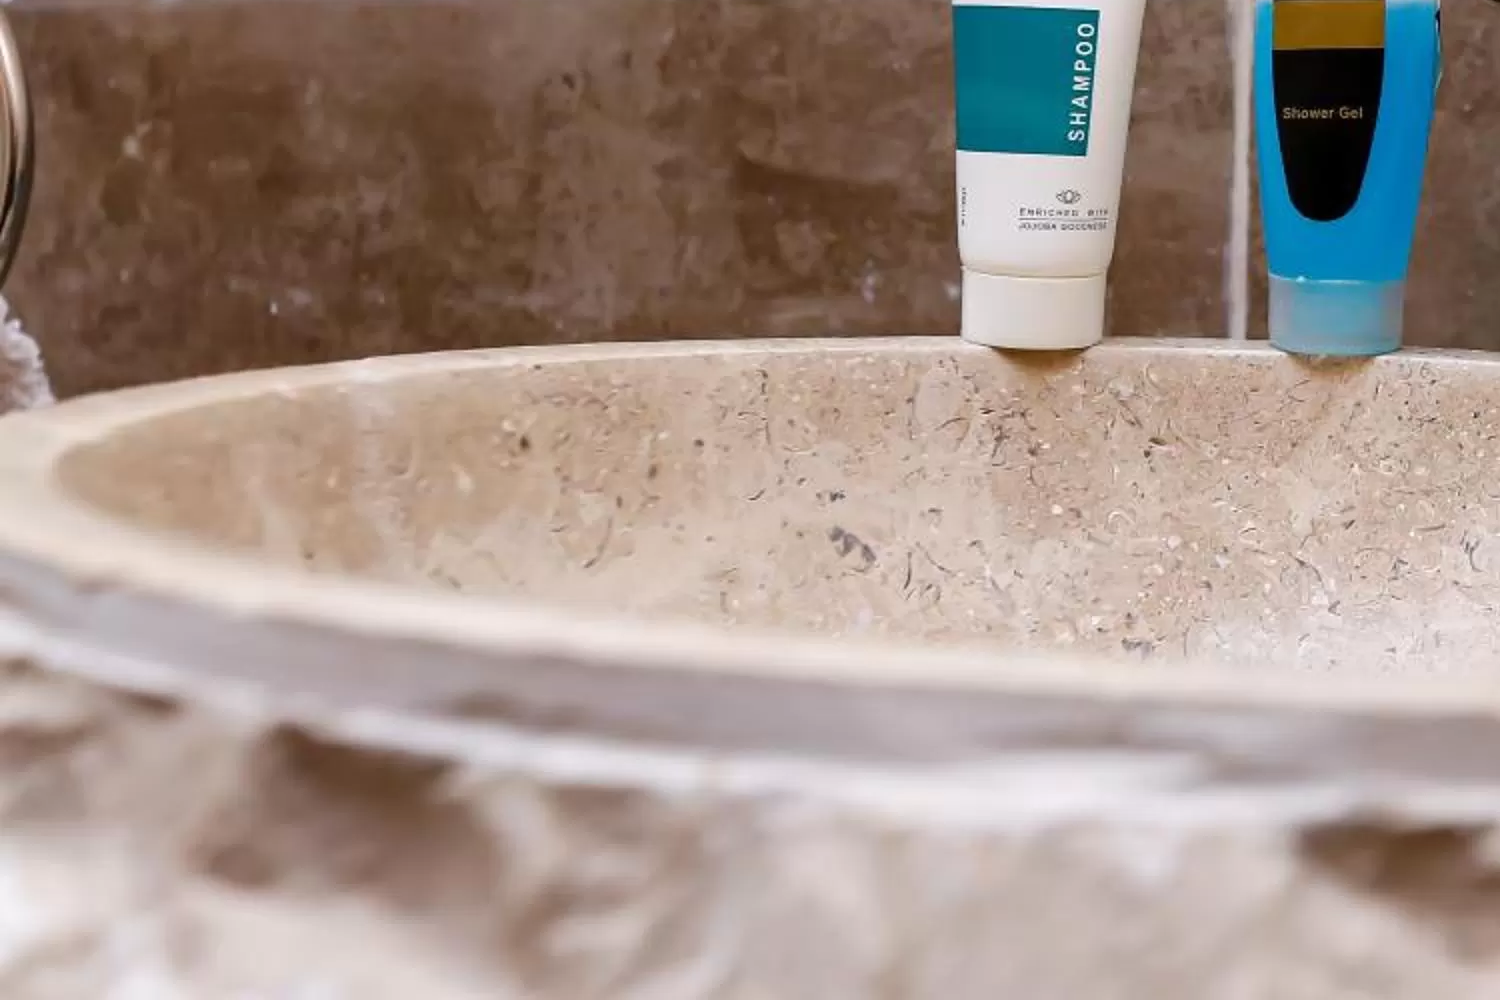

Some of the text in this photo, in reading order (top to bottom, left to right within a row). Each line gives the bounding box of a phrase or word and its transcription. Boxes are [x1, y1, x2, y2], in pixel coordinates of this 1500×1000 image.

[1067, 23, 1095, 142] SHAMPOO
[1283, 105, 1363, 119] Shower Gel
